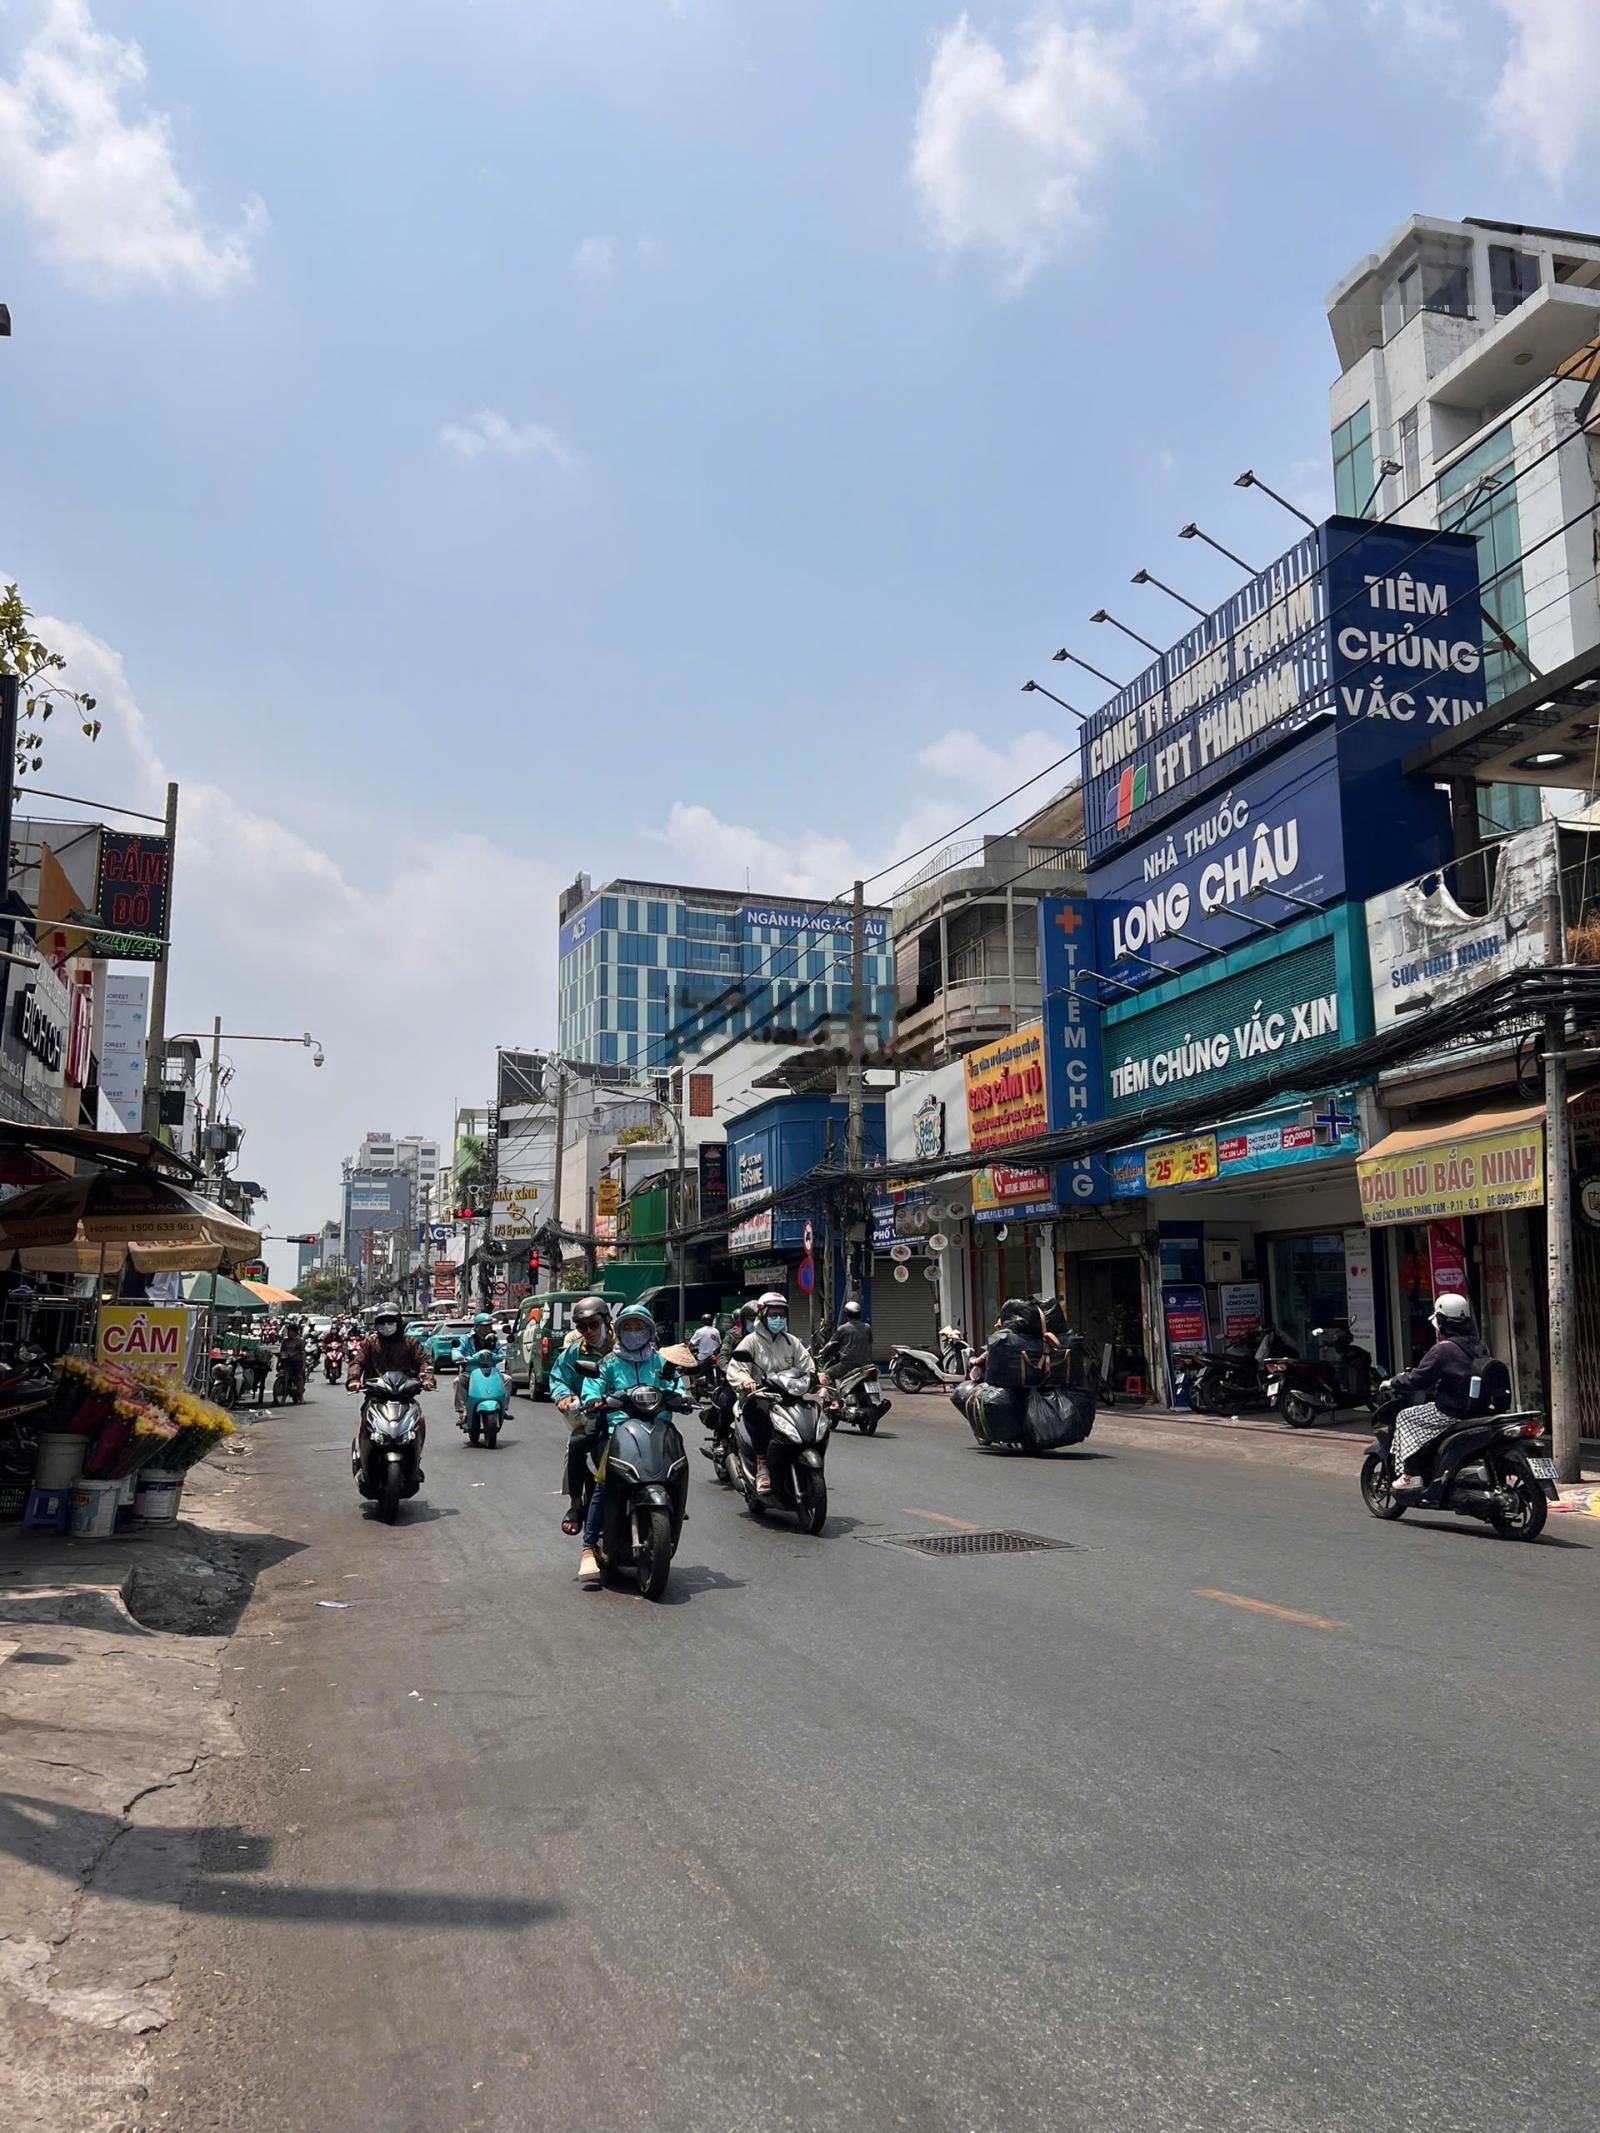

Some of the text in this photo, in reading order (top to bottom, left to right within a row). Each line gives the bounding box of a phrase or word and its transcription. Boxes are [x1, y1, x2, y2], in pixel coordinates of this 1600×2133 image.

[1364, 572, 1448, 616] TIÊM
[1338, 622, 1480, 674] CHỦNG
[1155, 659, 1299, 795] FPT PHARMA
[1340, 675, 1416, 721] VẮC
[1090, 713, 1138, 778] CÔNG
[1140, 689, 1166, 740] TY
[1143, 790, 1250, 883] NHÀ THUỐC
[1113, 882, 1190, 960] LONG
[1199, 818, 1299, 913] CHÂU
[747, 911, 788, 927] NGÂN
[791, 914, 830, 931] HÀNG
[1110, 994, 1339, 1099] TIÊM CHỦNG VẮC XIN
[1361, 1145, 1537, 1209] ĐẬU HŨ BẮC NINH
[131, 1223, 154, 1232] 1900
[156, 1222, 175, 1232] 633
[177, 1222, 195, 1231] 981
[103, 1314, 178, 1353] CẦM
